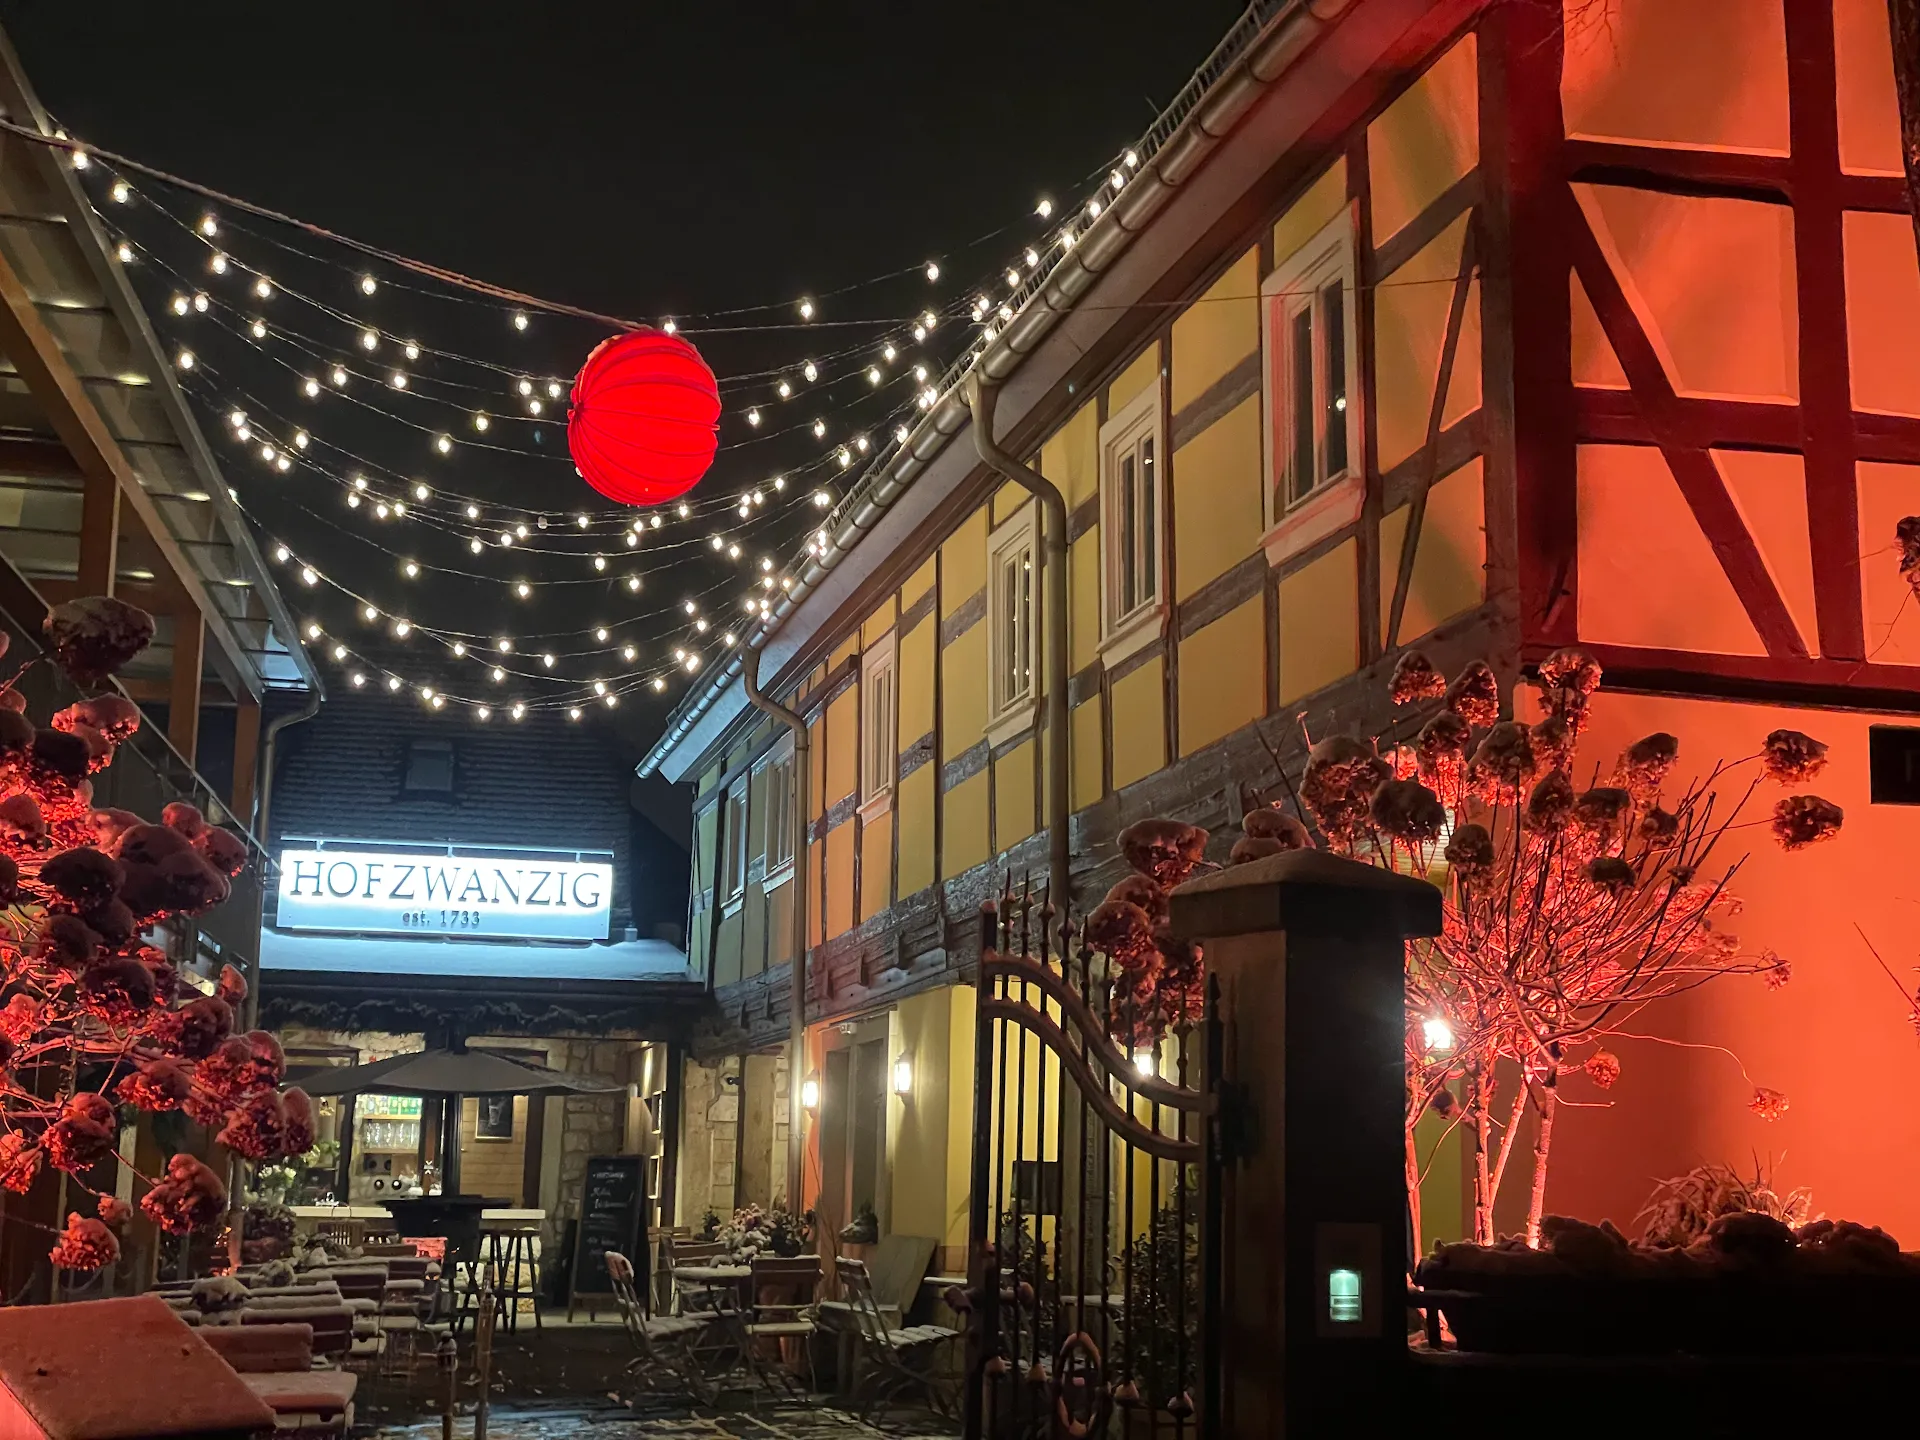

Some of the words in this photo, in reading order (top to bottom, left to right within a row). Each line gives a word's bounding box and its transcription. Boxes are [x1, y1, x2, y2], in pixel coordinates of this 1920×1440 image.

[290, 860, 600, 907] HOFZWANZIG
[402, 910, 430, 925] est.
[440, 910, 480, 927] 1733
